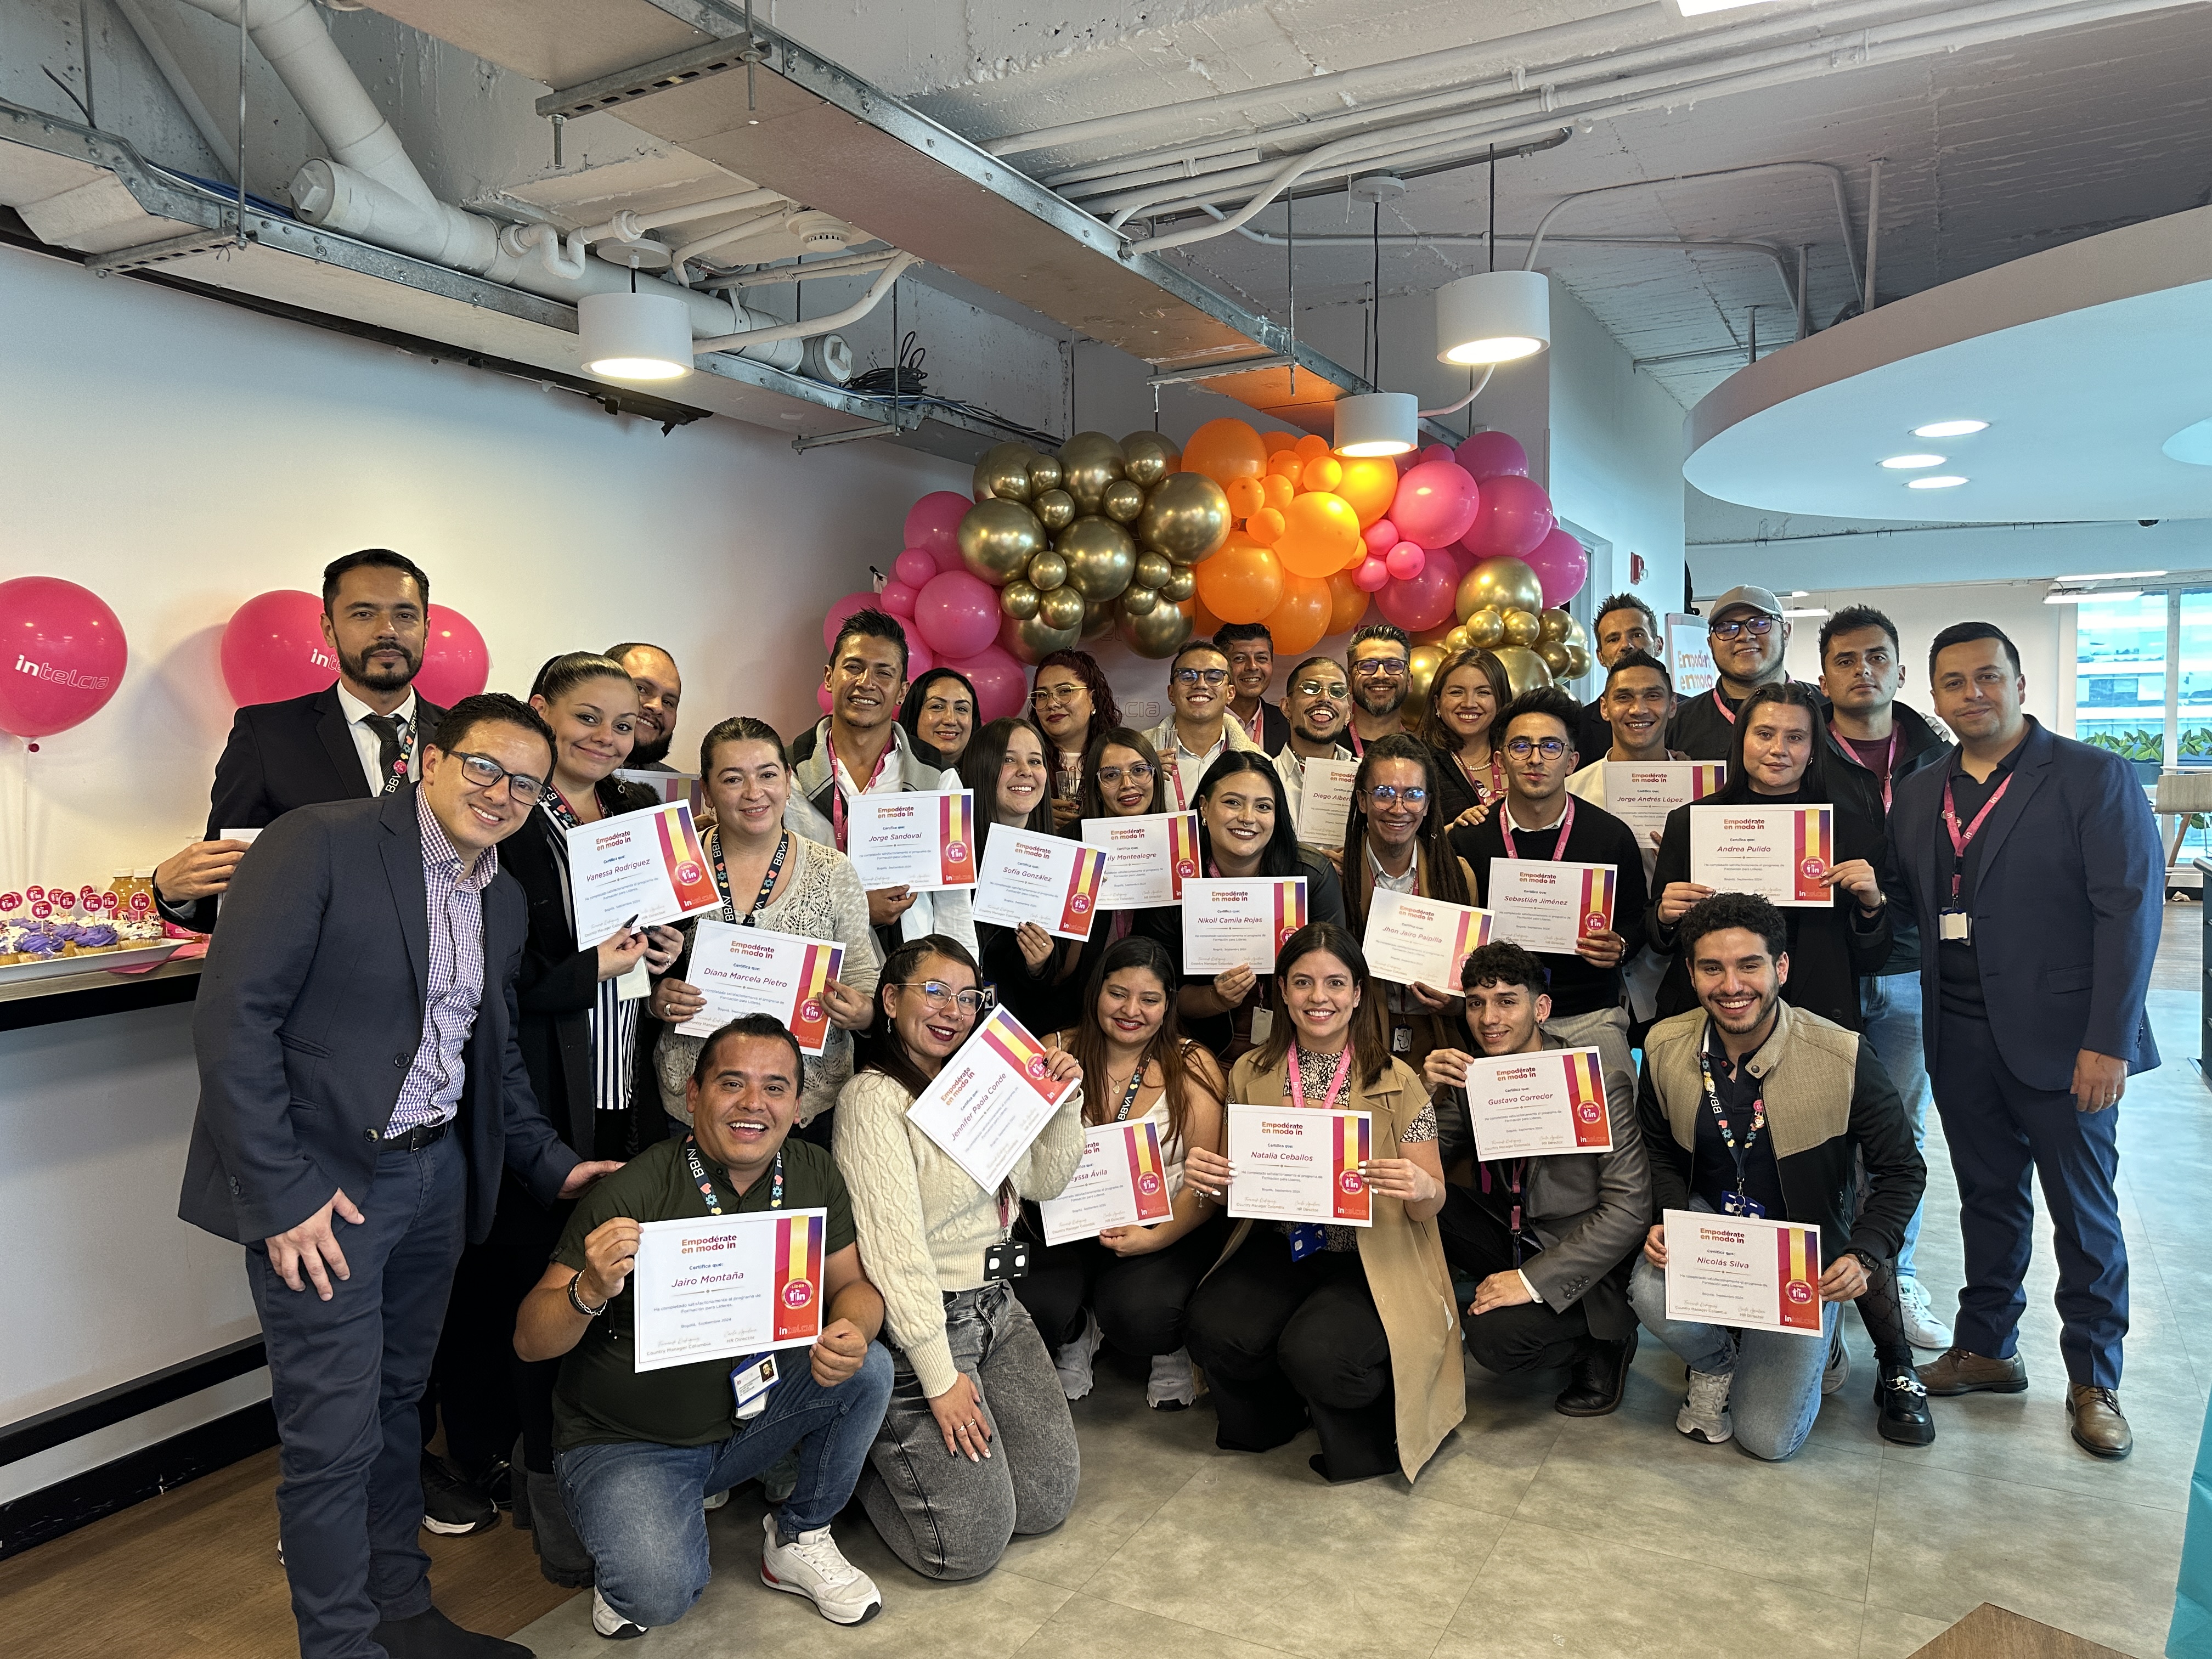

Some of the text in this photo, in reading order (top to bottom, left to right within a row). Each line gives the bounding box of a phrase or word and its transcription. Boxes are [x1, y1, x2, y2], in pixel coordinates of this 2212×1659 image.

[310, 648, 341, 673] inte
[15, 654, 110, 689] intelcia
[596, 831, 630, 844] Empodérate
[606, 839, 624, 849] modo
[712, 833, 721, 857] BBVA
[1016, 842, 1051, 854] Empodérate
[774, 841, 787, 866] BBVA
[587, 870, 613, 881] Vanessa
[615, 859, 650, 874] Rodríguez
[1022, 871, 1052, 882] González
[723, 895, 734, 921] BBVA
[1400, 905, 1434, 917] Empodérate
[1400, 929, 1416, 938] Jairo
[1418, 934, 1442, 943] Paipilla
[731, 941, 774, 953] Empodérate
[704, 968, 787, 988] Diana Marcela Pietro
[1497, 1067, 1536, 1076] Empodérate
[941, 1066, 970, 1102] Empodérate
[946, 1071, 975, 1105] en modo in
[1520, 1093, 1553, 1102] Corredor
[952, 1073, 1007, 1141] Jennifer Paola Conde
[1118, 1096, 1133, 1120] BBVA
[687, 1149, 704, 1178] BBVA
[1091, 1169, 1107, 1177] Ávila
[1700, 1228, 1745, 1238] Empodérate
[681, 1235, 737, 1246] Empodérate
[696, 1243, 724, 1252] modo
[1697, 1257, 1749, 1269] Nicolás Silva
[672, 1272, 744, 1288] Jairo Montaña
